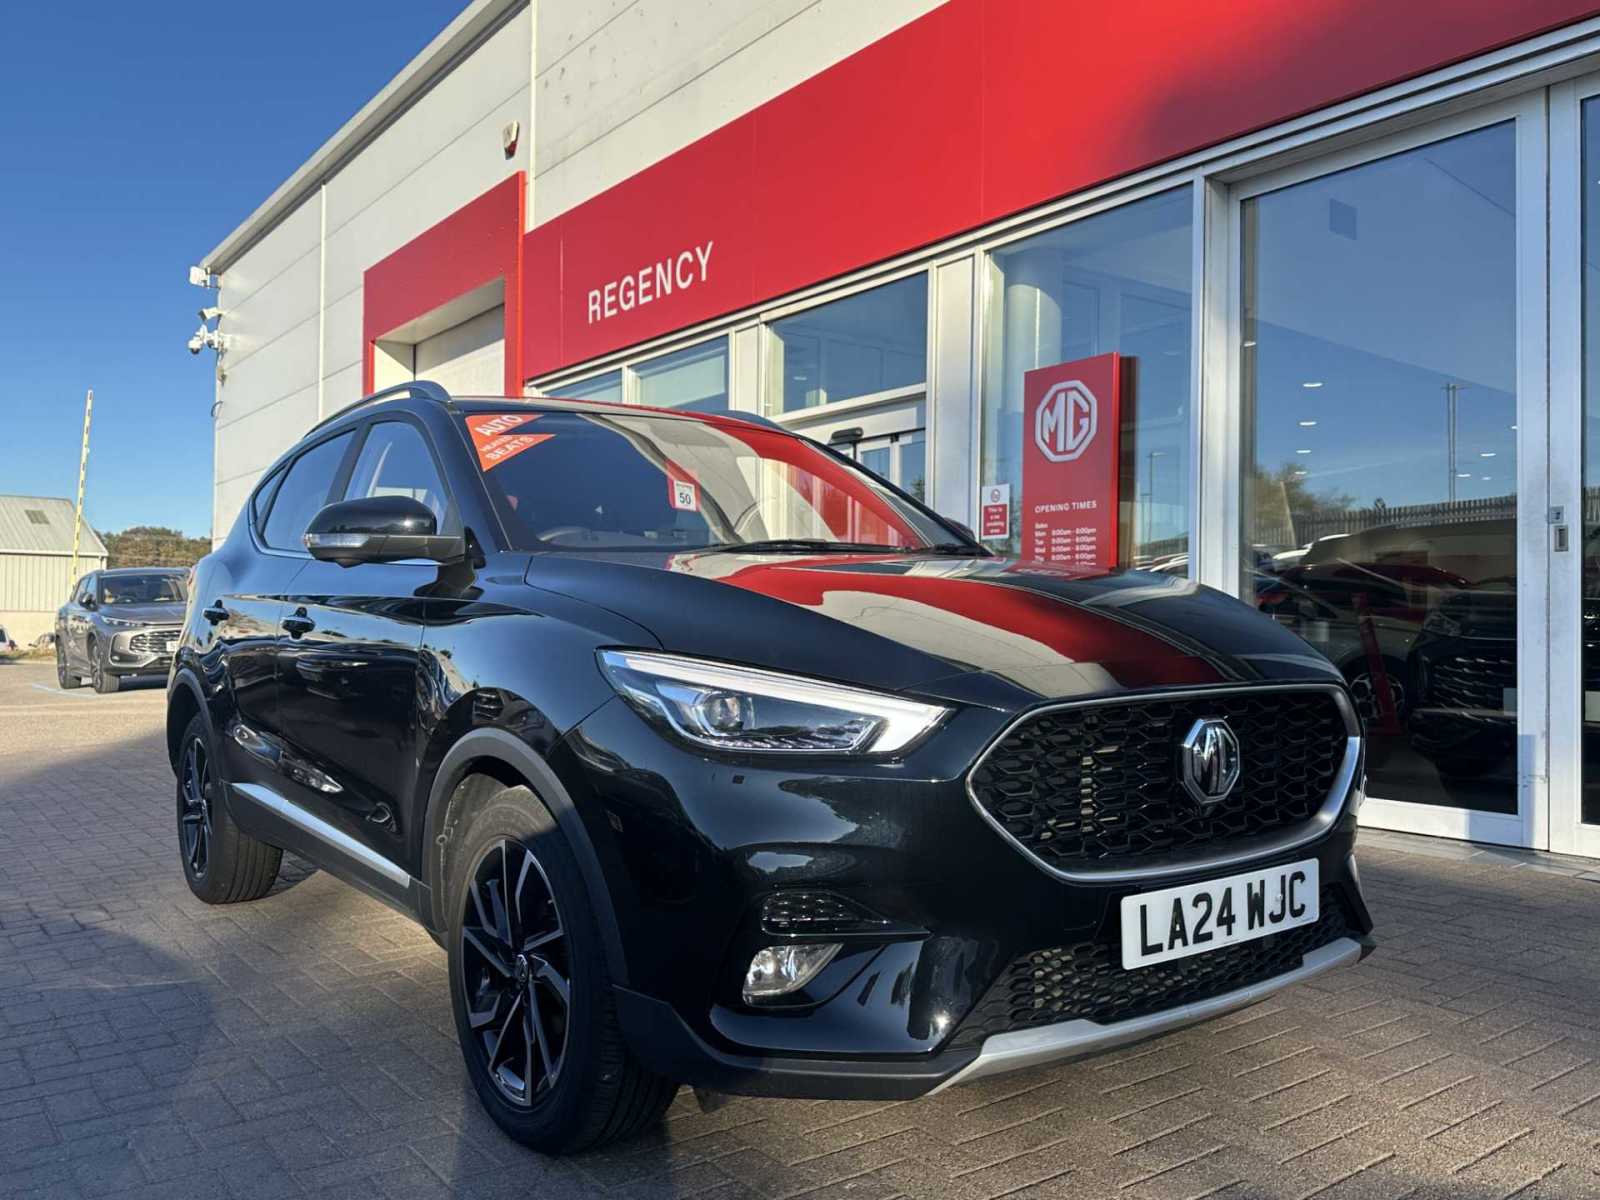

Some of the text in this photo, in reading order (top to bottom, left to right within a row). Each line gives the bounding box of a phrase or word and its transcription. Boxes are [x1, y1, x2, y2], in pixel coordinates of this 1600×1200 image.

[588, 240, 713, 324] REGENCY
[475, 414, 523, 436] AUTO
[1041, 389, 1091, 453] MG
[485, 436, 534, 459] SEATS
[1034, 500, 1097, 513] OPENING TIMES
[1140, 871, 1306, 956] LA24 WJC
